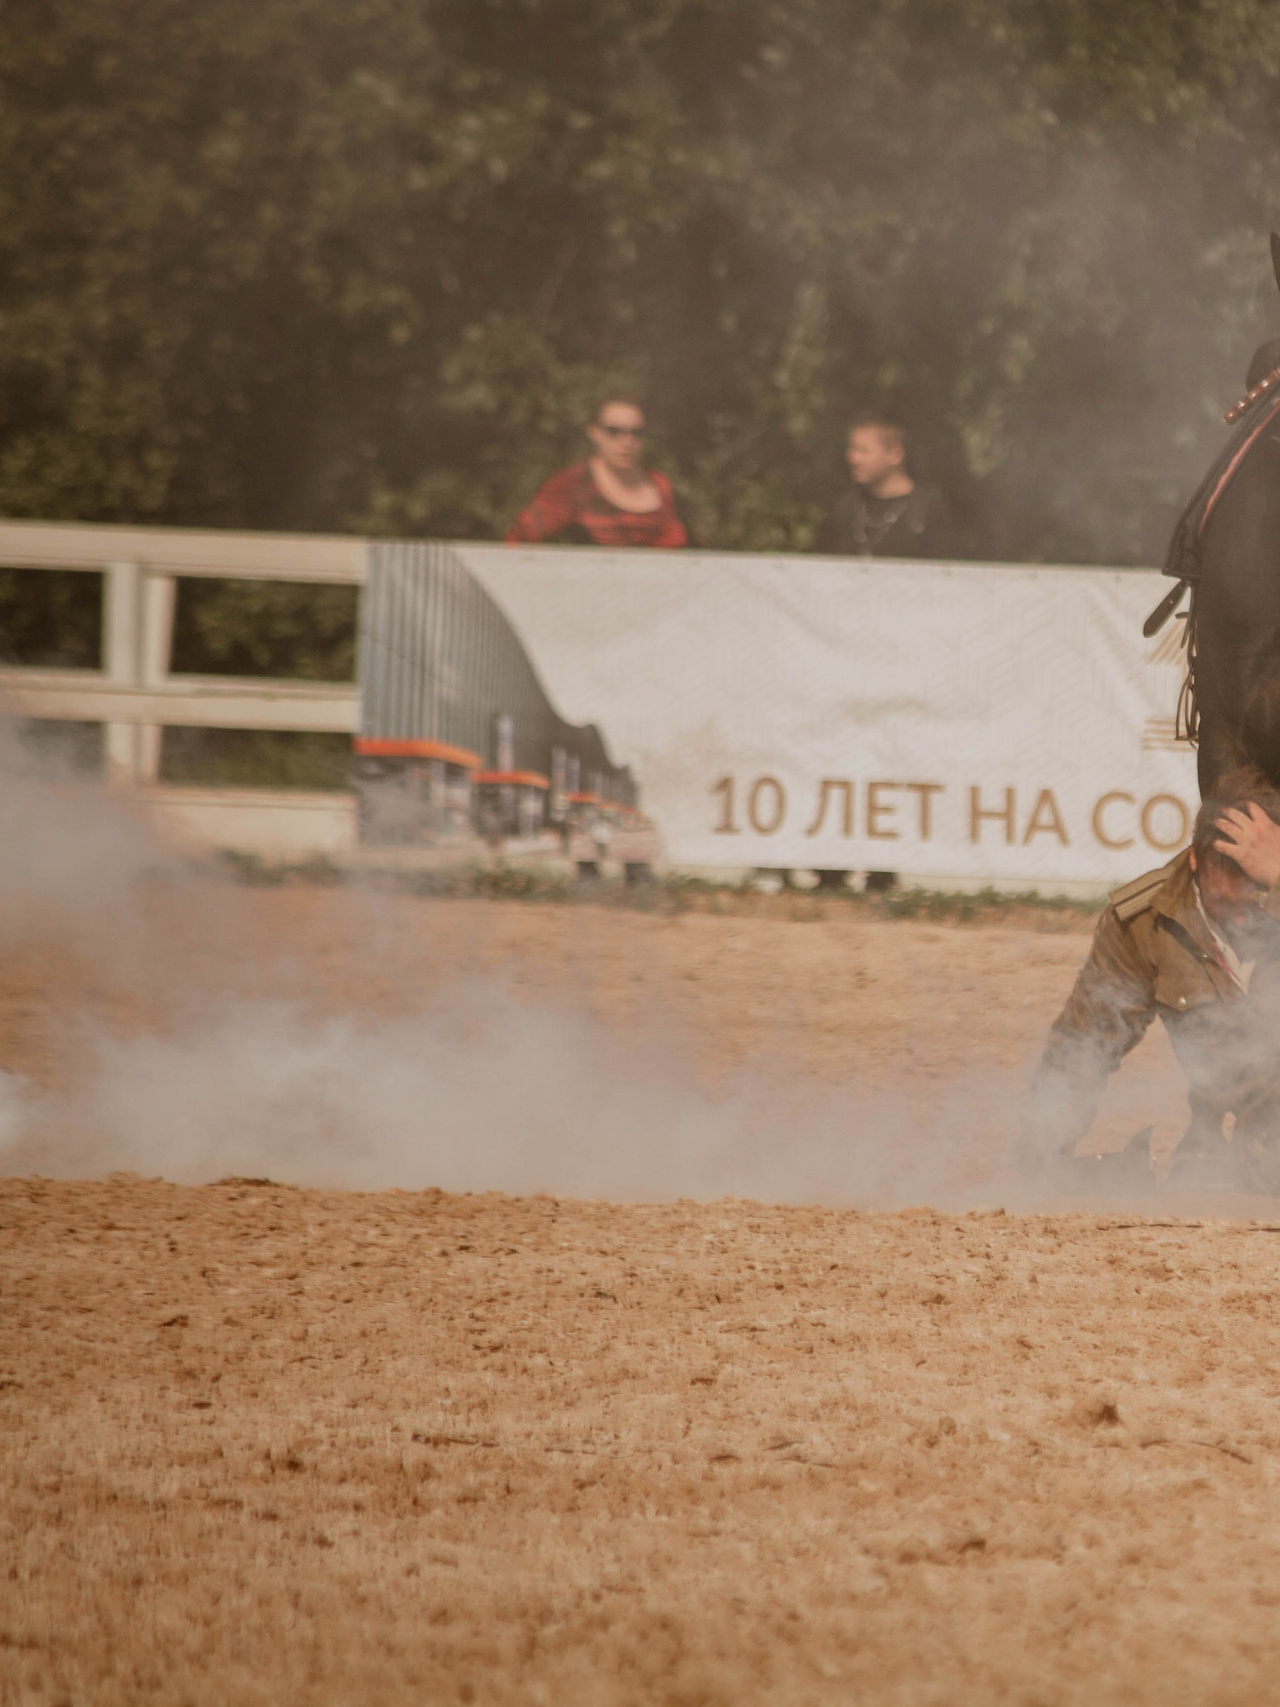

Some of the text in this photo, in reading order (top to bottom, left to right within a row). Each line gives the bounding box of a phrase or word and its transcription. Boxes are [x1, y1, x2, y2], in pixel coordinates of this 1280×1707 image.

[710, 776, 787, 836] 10
[805, 779, 946, 841] ЛЕТ
[968, 785, 1070, 848] НА
